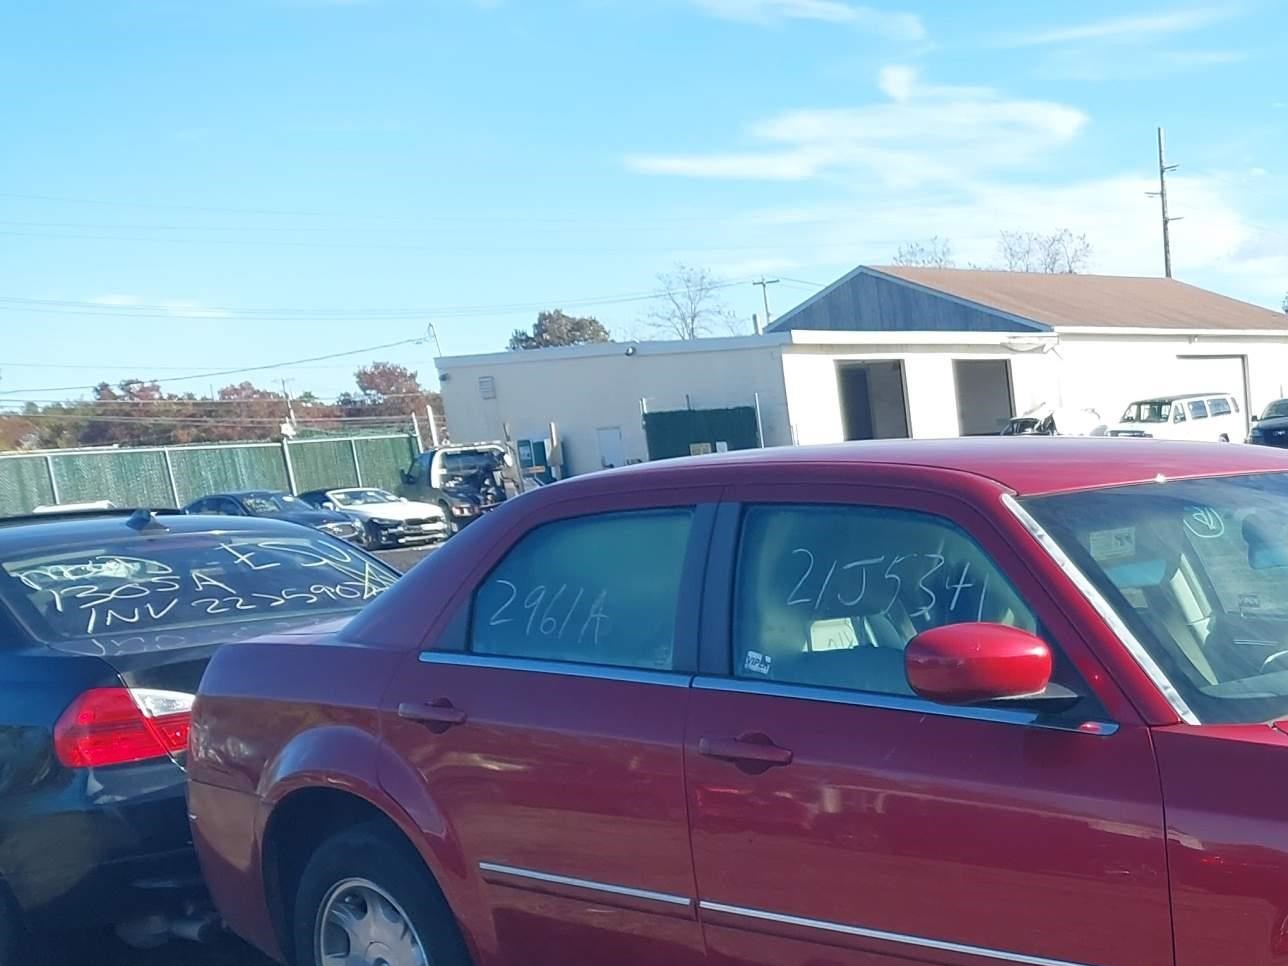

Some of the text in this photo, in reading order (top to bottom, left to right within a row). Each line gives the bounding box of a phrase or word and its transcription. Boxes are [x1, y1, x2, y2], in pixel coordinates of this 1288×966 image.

[87, 599, 179, 634] INV
[489, 580, 609, 645] 2961A
[787, 548, 990, 622] 21J5341
